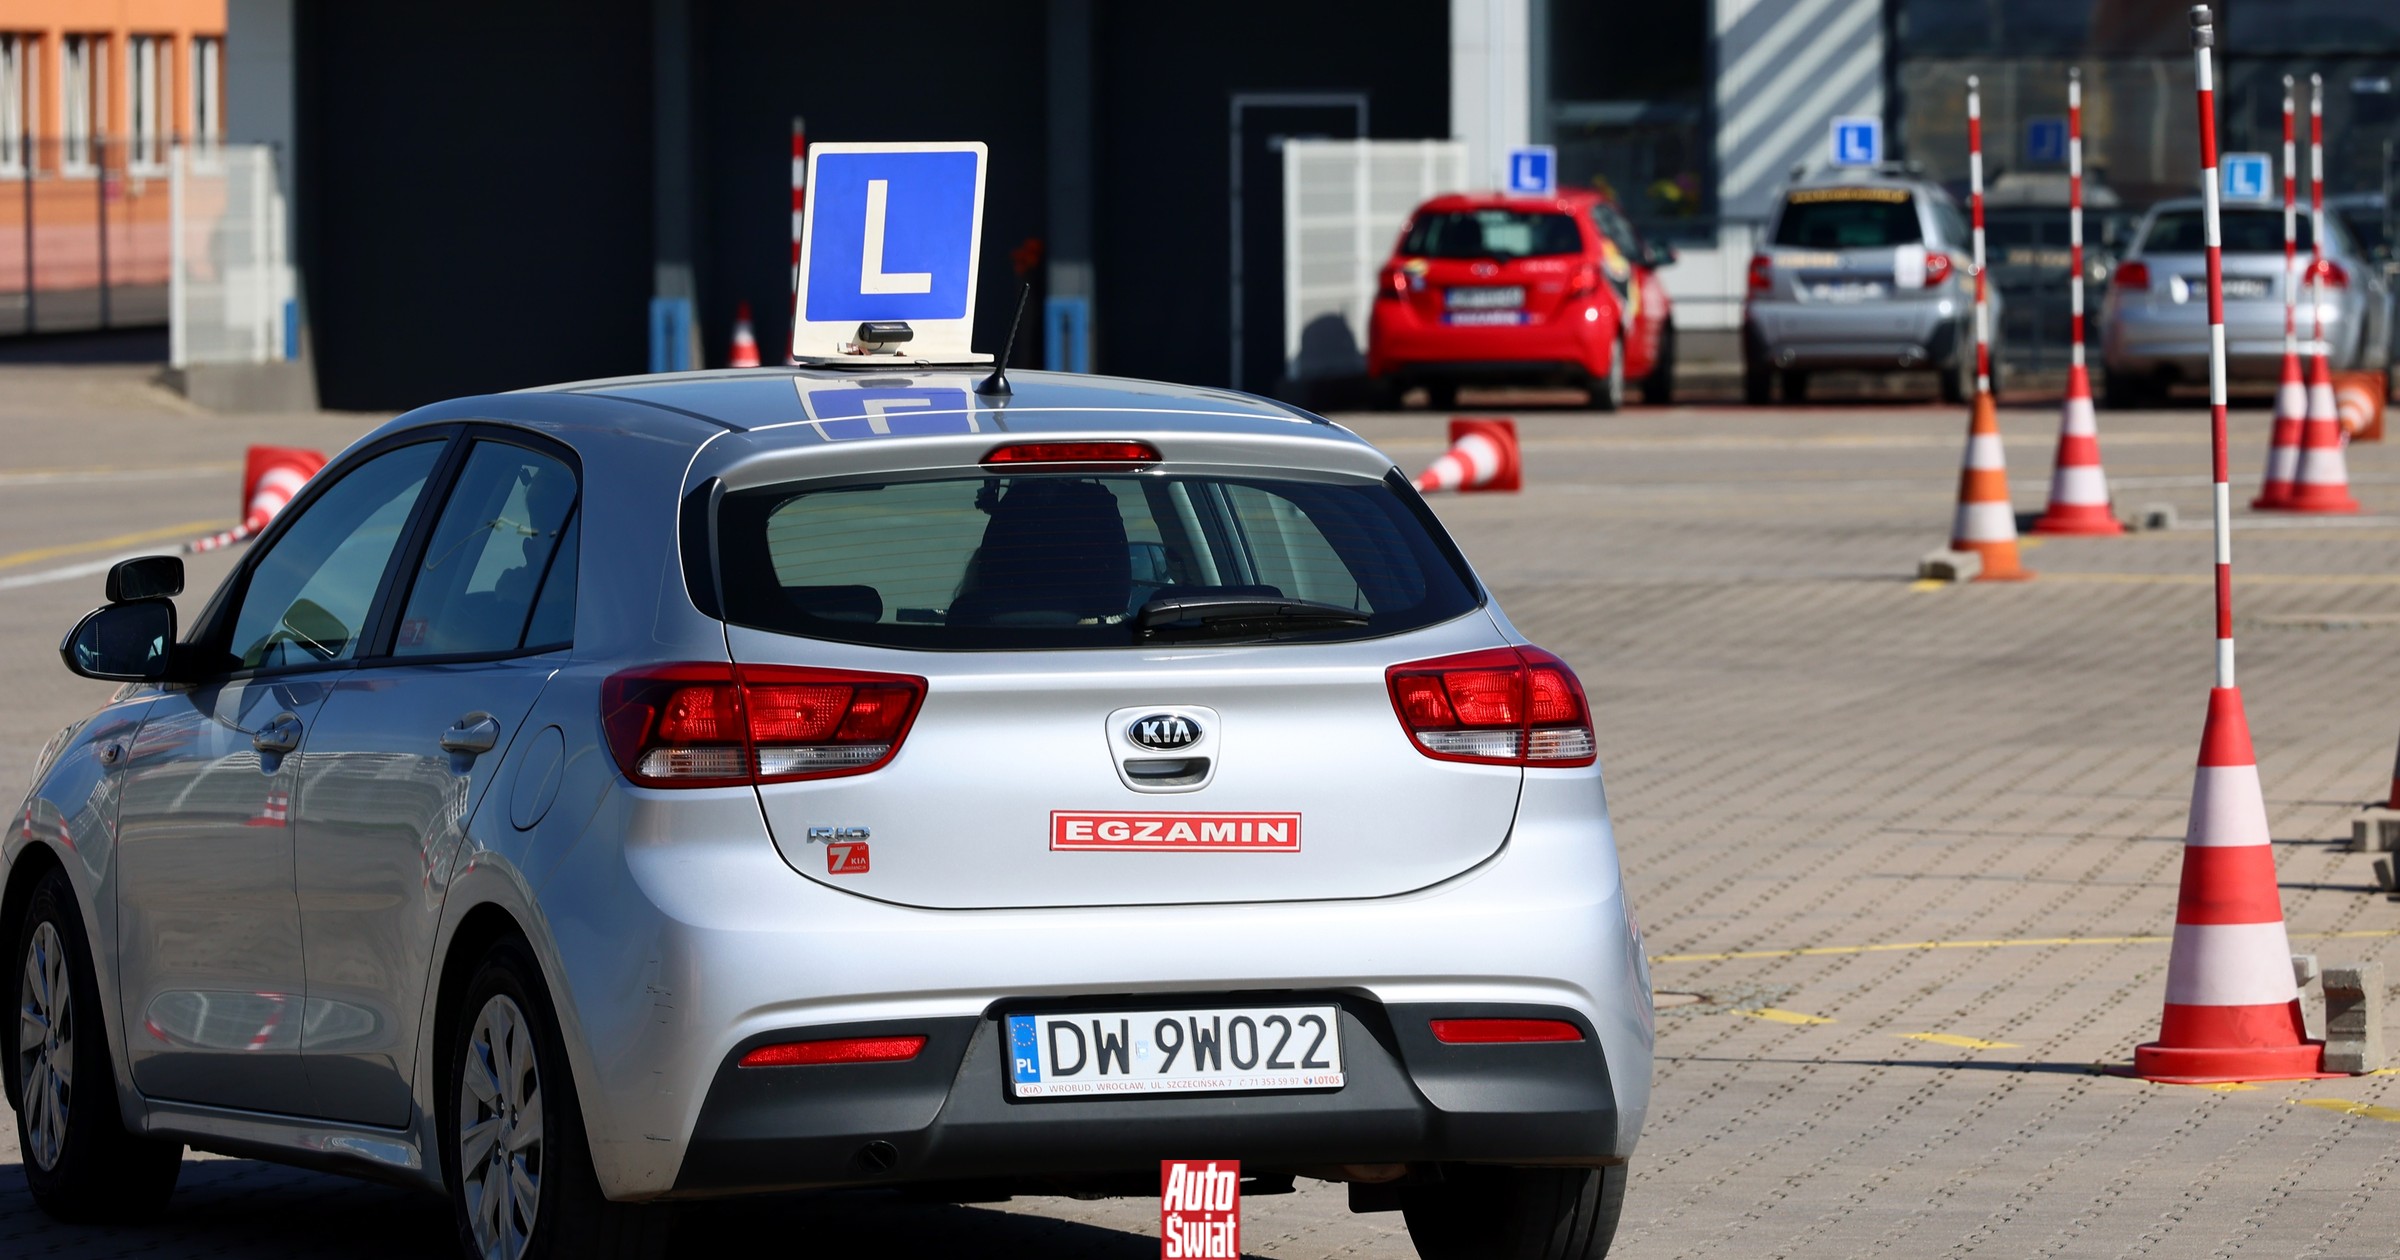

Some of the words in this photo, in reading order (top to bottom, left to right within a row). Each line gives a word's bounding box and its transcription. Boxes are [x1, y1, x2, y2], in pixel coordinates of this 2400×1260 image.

[1846, 127, 1869, 160] L
[1518, 155, 1543, 187] L
[2234, 160, 2256, 194] L
[860, 179, 932, 295] L
[1142, 721, 1192, 744] KIA
[807, 827, 870, 843] RIO
[1065, 819, 1289, 844] EGZAMIN
[830, 846, 852, 871] 7
[851, 857, 866, 865] KIA
[1047, 1019, 1130, 1077] DW
[1154, 1014, 1330, 1074] 9W022
[1016, 1058, 1036, 1074] PL
[1023, 1085, 1039, 1094] KIA
[1049, 1084, 1093, 1093] WROBUD,
[1096, 1082, 1146, 1092] WROCŁAW,
[1150, 1081, 1164, 1090] UL.
[1166, 1078, 1225, 1089] SZCZECIŃSKA
[1227, 1079, 1232, 1087] 7
[1314, 1076, 1340, 1085] LOTOS
